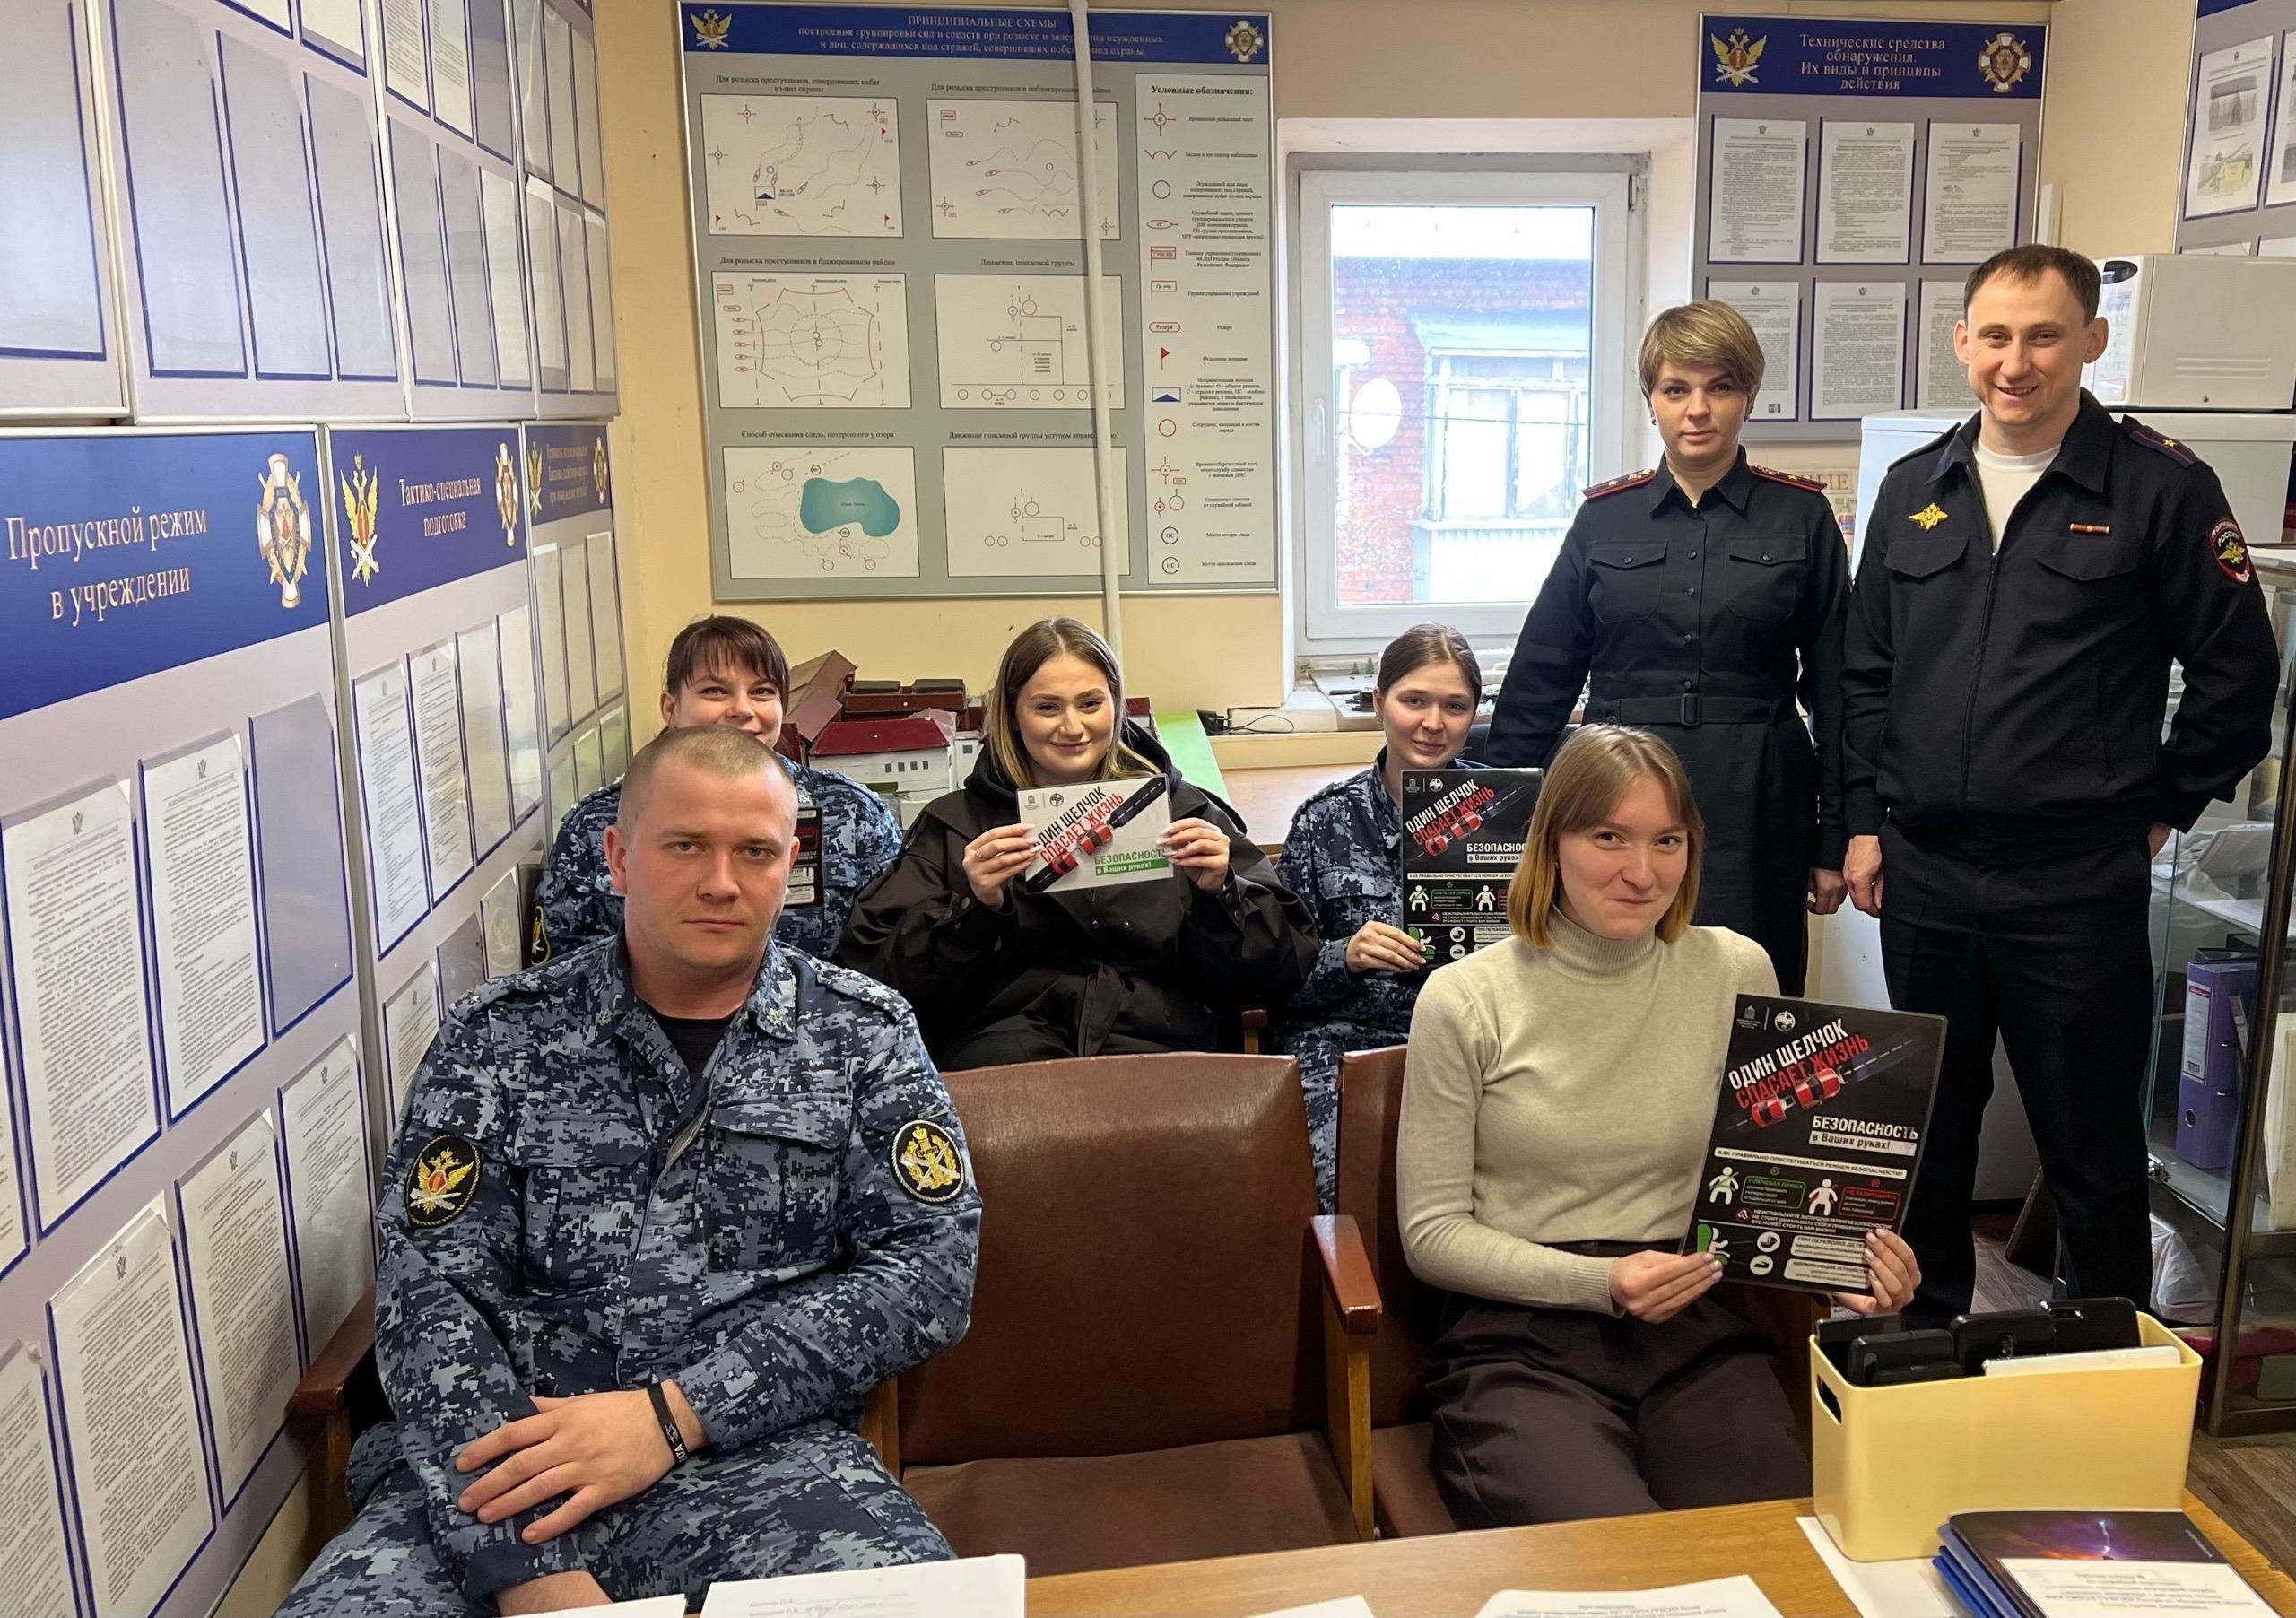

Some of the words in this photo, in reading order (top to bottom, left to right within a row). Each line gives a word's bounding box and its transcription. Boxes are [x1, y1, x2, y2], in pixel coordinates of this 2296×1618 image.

[908, 15, 1013, 28] ПРИНЦИПИАЛЬНЫЕ
[1016, 18, 1057, 29] СХЕМЫ
[798, 27, 853, 38] построения
[856, 29, 916, 39] группировки
[918, 30, 935, 39] сил
[946, 31, 981, 40] средств
[985, 32, 1000, 42] при
[1003, 33, 1039, 43] розыске
[1107, 35, 1163, 45] осужденных
[1800, 33, 1883, 48] Технические
[1888, 39, 1945, 52] средства
[829, 42, 848, 50] лиц,
[851, 42, 918, 52] содержащихся
[922, 43, 938, 52] под
[941, 44, 981, 53] стражей,
[984, 45, 1048, 54] совершивших
[1110, 48, 1144, 57] охраны
[1826, 49, 1917, 65] обнаружения.
[716, 75, 729, 83] Для
[1801, 61, 1819, 74] Их
[1823, 65, 1857, 75] виды
[1861, 65, 1869, 75] и
[1874, 65, 1941, 79] принципы
[1152, 85, 1195, 94] Условные
[1196, 86, 1253, 95] обозначения:
[1839, 77, 1900, 90] действия
[764, 258, 811, 266] преступников
[980, 258, 1013, 266] Движение
[949, 431, 982, 439] Движение
[399, 477, 482, 506] Тактико-специальная
[423, 511, 466, 537] подготовка
[4, 505, 144, 570] Пропускной
[148, 509, 207, 551] режим
[50, 590, 64, 620] в
[70, 567, 190, 627] учреждении
[1405, 807, 1437, 834] ОДИН
[1433, 778, 1480, 815] ЩЕЛЧОК
[1033, 821, 1065, 848] ДИН
[1060, 786, 1107, 828] ЩЕЛЧОК
[1413, 811, 1461, 846] СПАСАЕТ
[1458, 786, 1496, 815] ЖИЗНЬ
[1040, 822, 1090, 863] СПАСАЕТ
[1084, 793, 1125, 830] ЖИЗНЬ
[1103, 865, 1127, 874] Ваших
[1128, 863, 1152, 874] руках!
[1728, 1056, 1776, 1090] ОДИН
[1775, 1018, 1849, 1066] ЩЕЛЧОК
[1735, 1062, 1812, 1109] СПАСАЕТ
[1810, 1033, 1871, 1072] ЖИЗНЬ
[1812, 1115, 1918, 1141] БЕЗОПАСНОСТЬ
[1812, 1134, 1818, 1142] в
[1821, 1133, 1855, 1146] Ваших
[1857, 1137, 1891, 1151] руках!
[1732, 1152, 1769, 1161] ПРАВИЛЬНО
[1770, 1156, 1824, 1166] ПРИСТЕГИВАТЬСЯ
